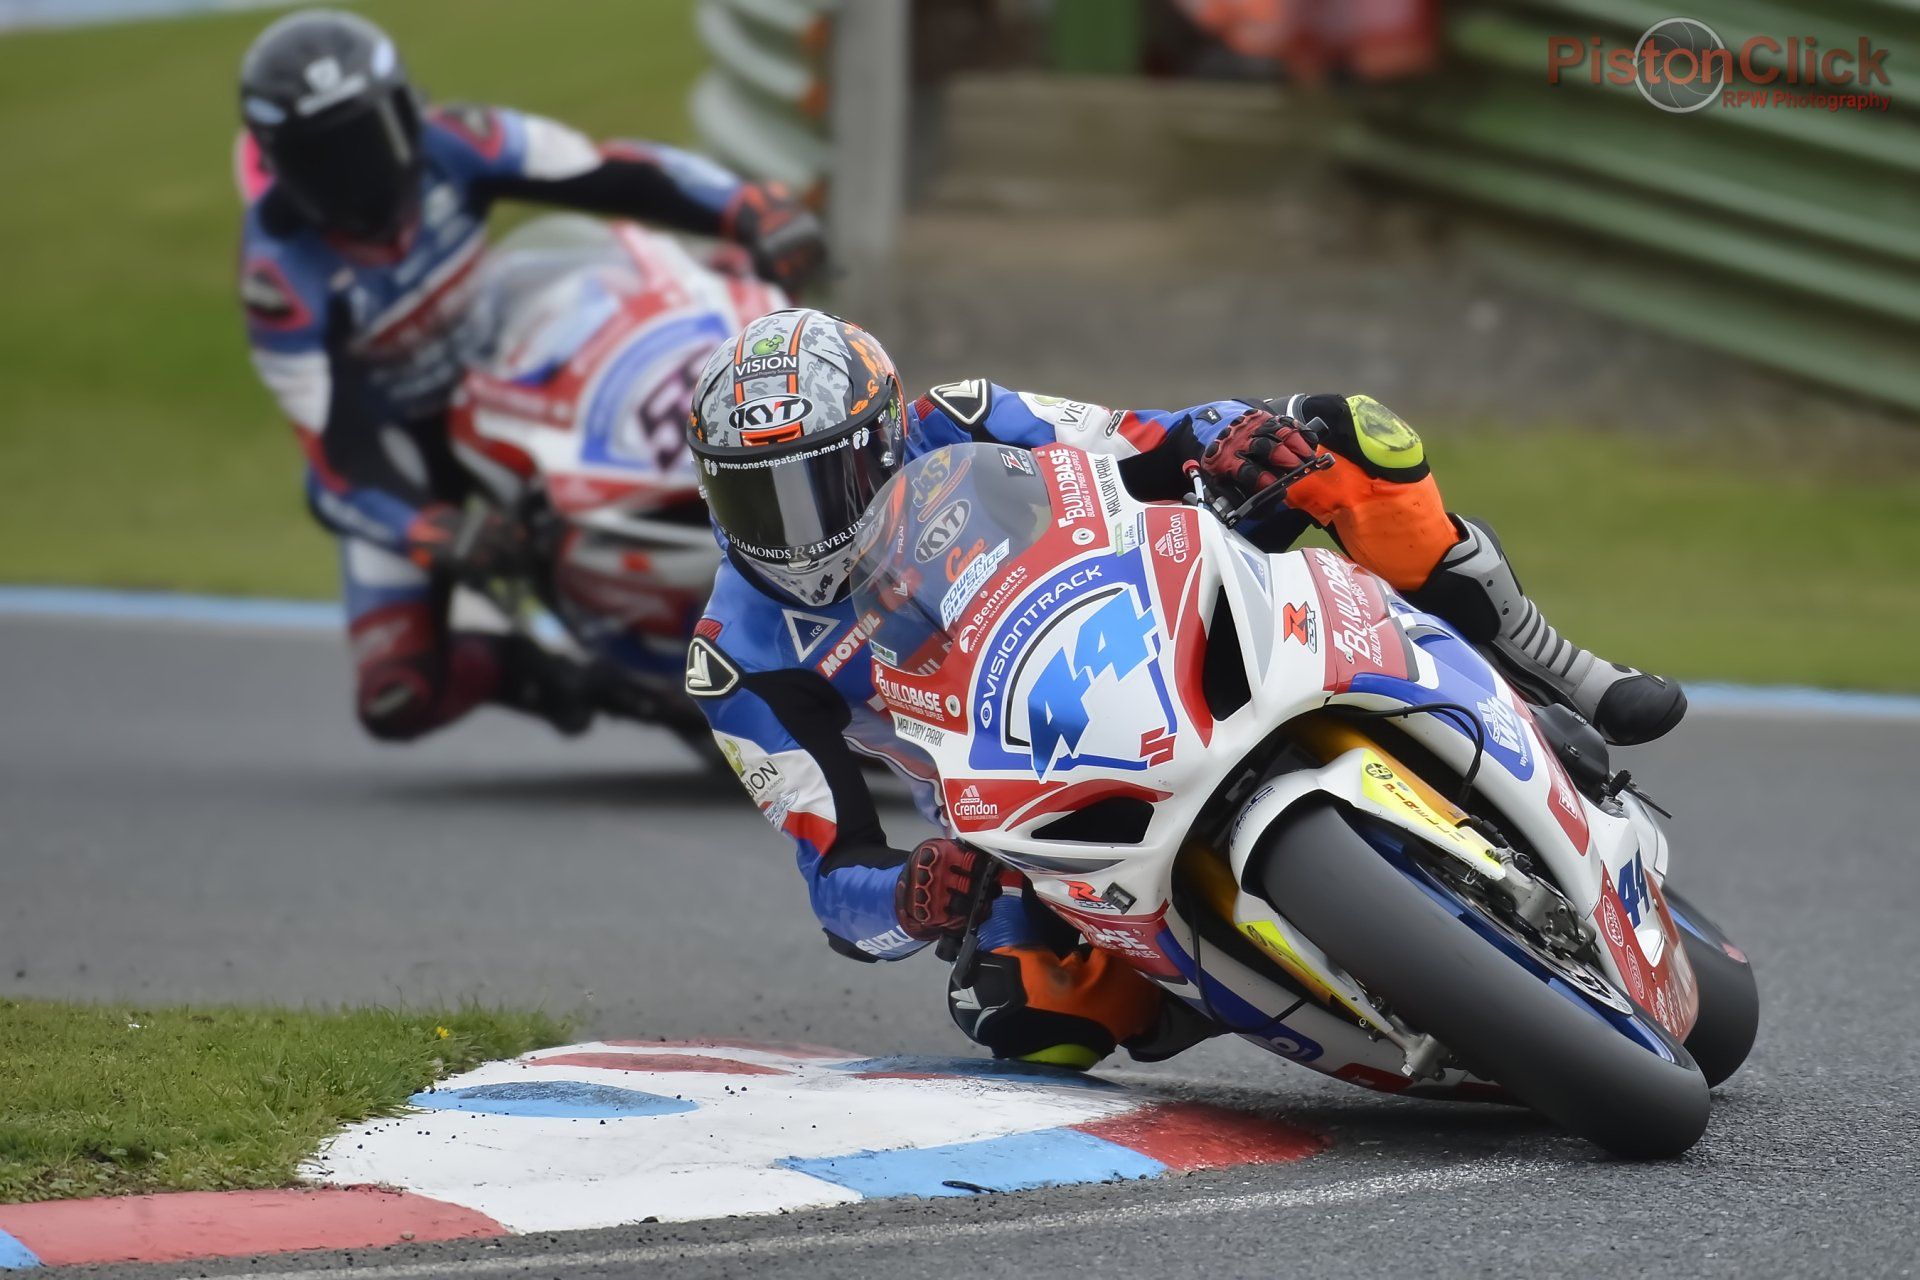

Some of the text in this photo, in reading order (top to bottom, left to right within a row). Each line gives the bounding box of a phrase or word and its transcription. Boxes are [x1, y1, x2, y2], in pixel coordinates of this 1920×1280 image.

[735, 355, 797, 378] VISION
[736, 398, 801, 429] KYT
[719, 438, 850, 470] www.onestepatatime.me.uk
[1095, 456, 1113, 479] PARK
[1050, 448, 1086, 520] BUILDBASE
[1099, 479, 1122, 518] MALLORY
[729, 533, 792, 560] DIAMONDS
[808, 517, 867, 555] 4EVER.UK
[1168, 513, 1187, 564] Crendon
[972, 564, 1027, 627] Bennetts
[987, 574, 1028, 621] SUPERBIKES
[809, 623, 824, 639] ICE
[819, 612, 881, 678] MOTUL
[983, 564, 1103, 699] VISIONTRACK
[879, 678, 944, 714] BUILDBASE
[1027, 588, 1157, 783] 44
[896, 715, 946, 748] MALLORY PARK
[954, 800, 998, 817] Crendon
